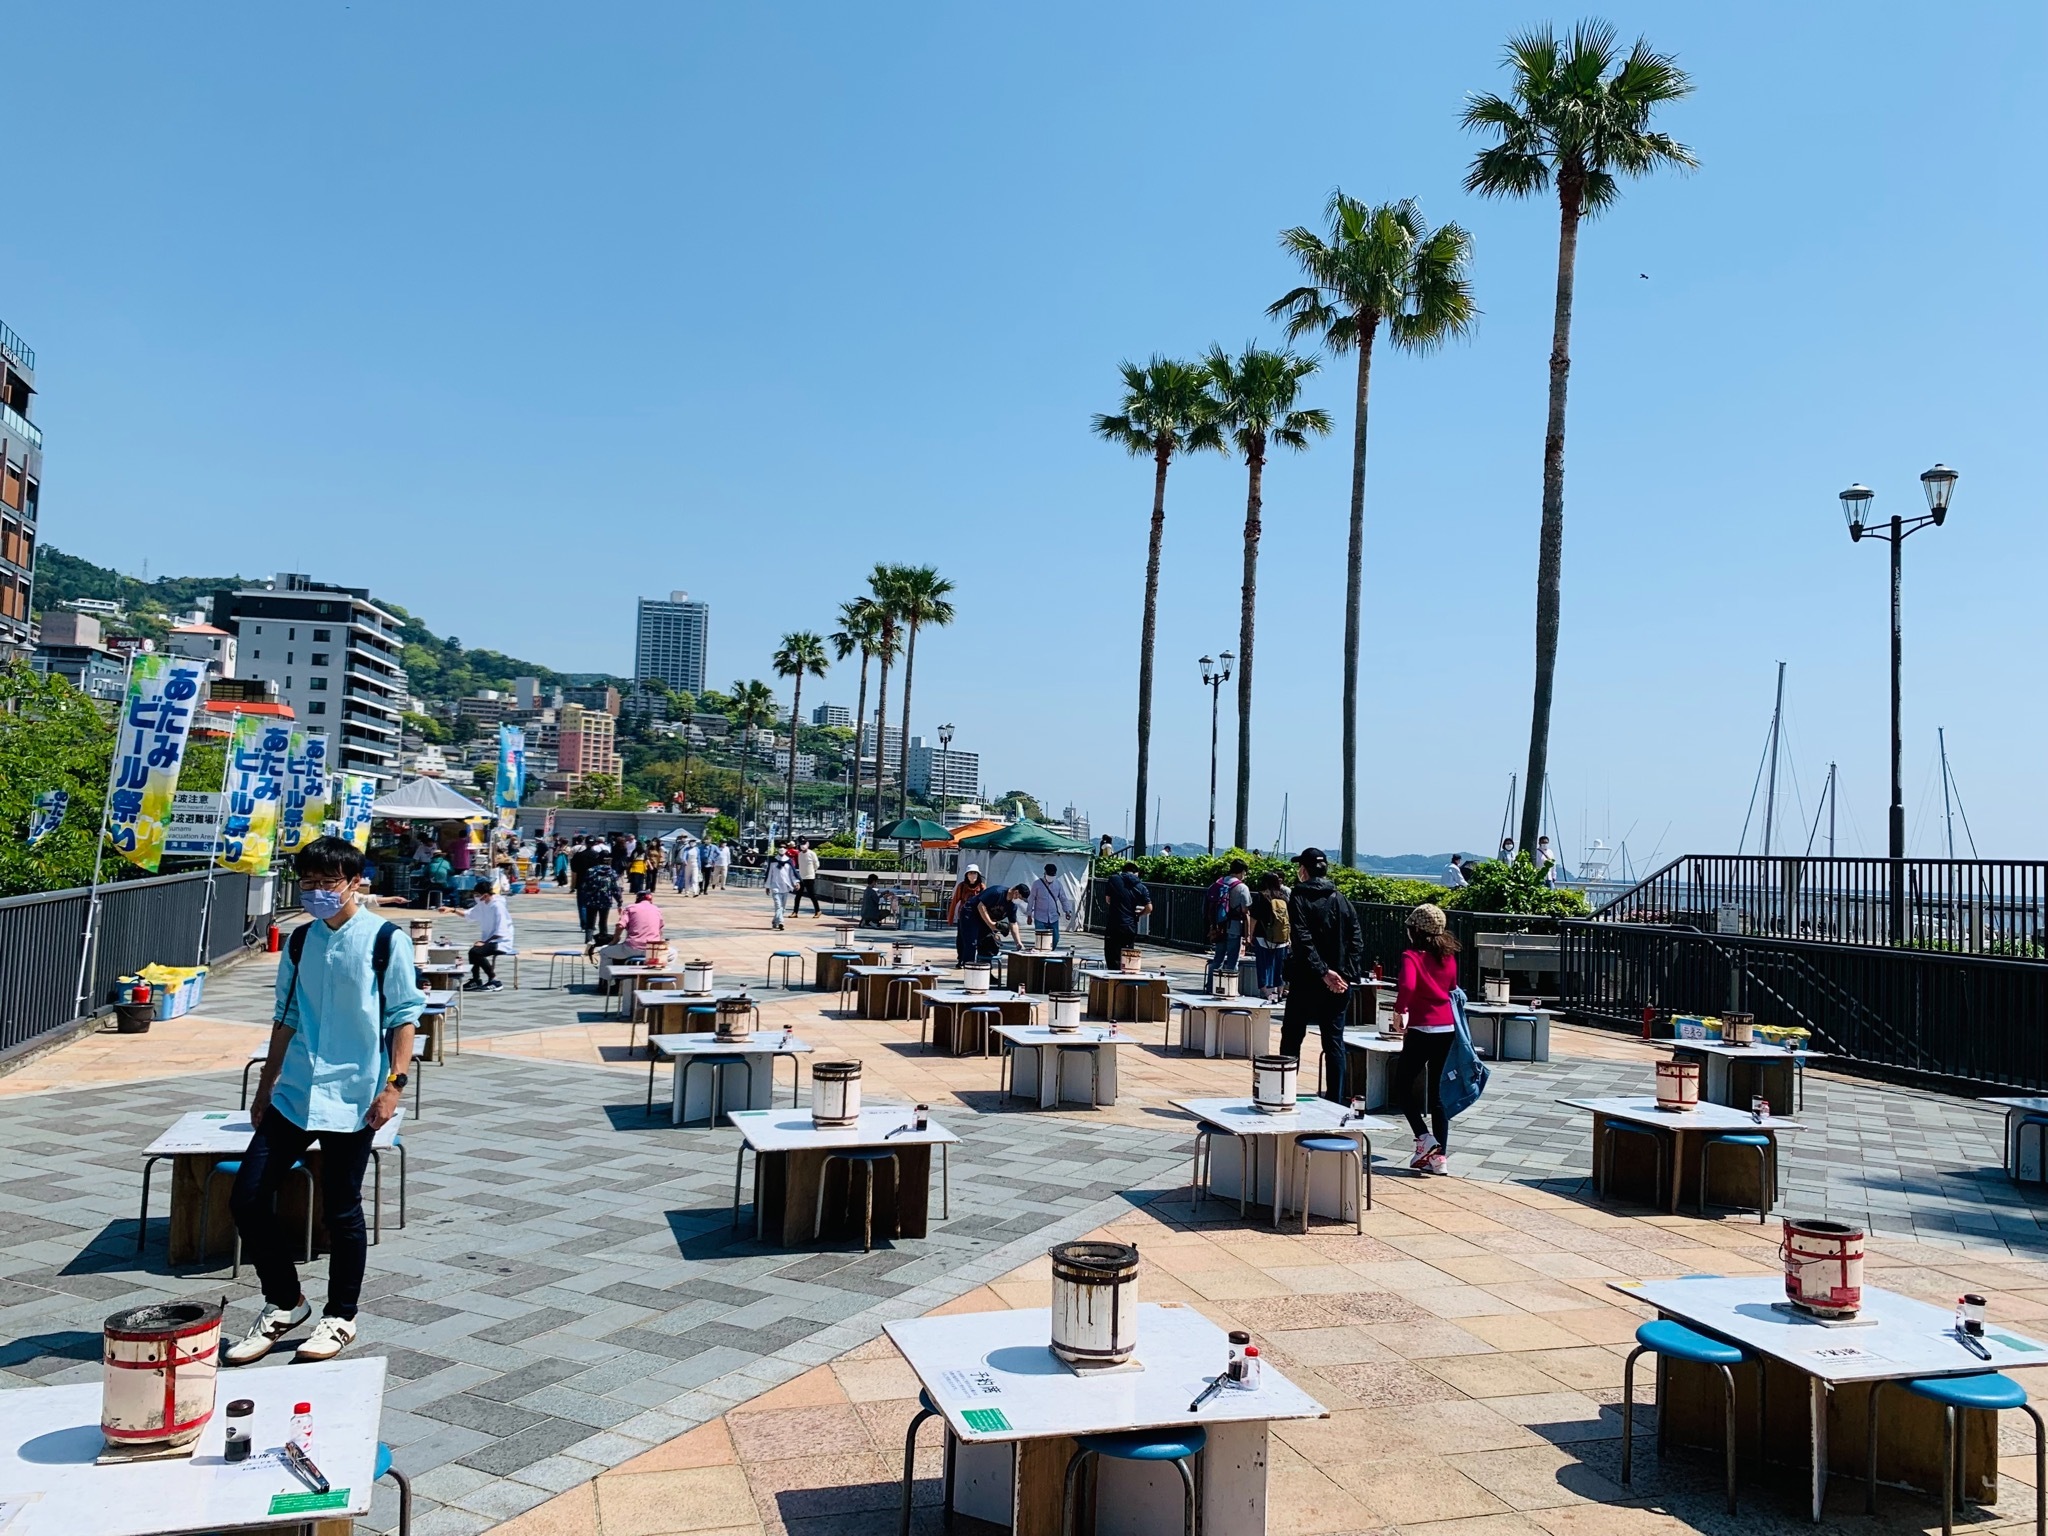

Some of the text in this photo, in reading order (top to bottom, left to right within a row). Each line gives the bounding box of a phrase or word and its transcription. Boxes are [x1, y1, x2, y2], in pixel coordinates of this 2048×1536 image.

[147, 668, 199, 769] あたみ
[111, 695, 163, 852] ビール祭り
[224, 747, 261, 863] ビール祭り
[252, 727, 289, 801] あたみ
[284, 755, 306, 847] ビール祭り
[304, 740, 325, 796] あたみ
[357, 782, 374, 823] あたみ
[44, 790, 68, 831] あたみ
